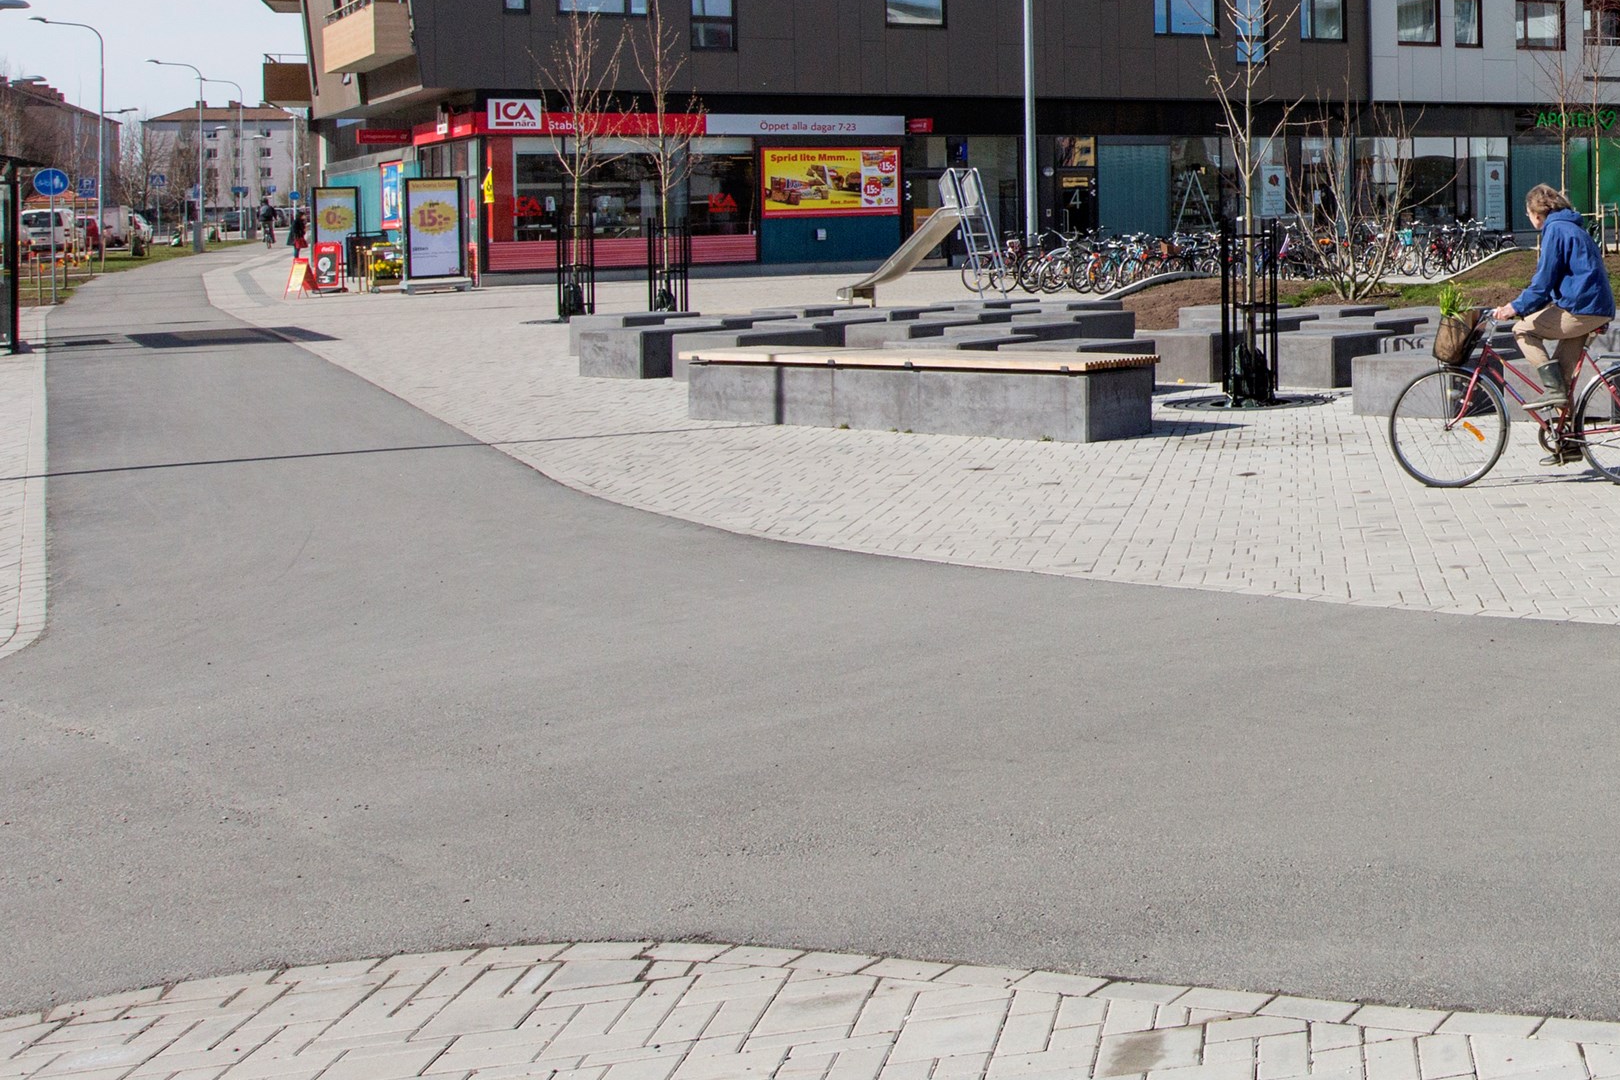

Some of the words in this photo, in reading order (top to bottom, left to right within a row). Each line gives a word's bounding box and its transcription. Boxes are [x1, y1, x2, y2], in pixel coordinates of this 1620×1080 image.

[495, 102, 535, 120] ICA
[760, 120, 790, 131] Öppet
[792, 121, 808, 131] alla
[811, 122, 836, 134] dagar
[838, 122, 857, 131] 7-23
[770, 153, 798, 164] Sprid
[800, 154, 816, 162] lite
[510, 196, 541, 211] ICA
[708, 193, 737, 207] ICA
[1069, 188, 1082, 209] 4
